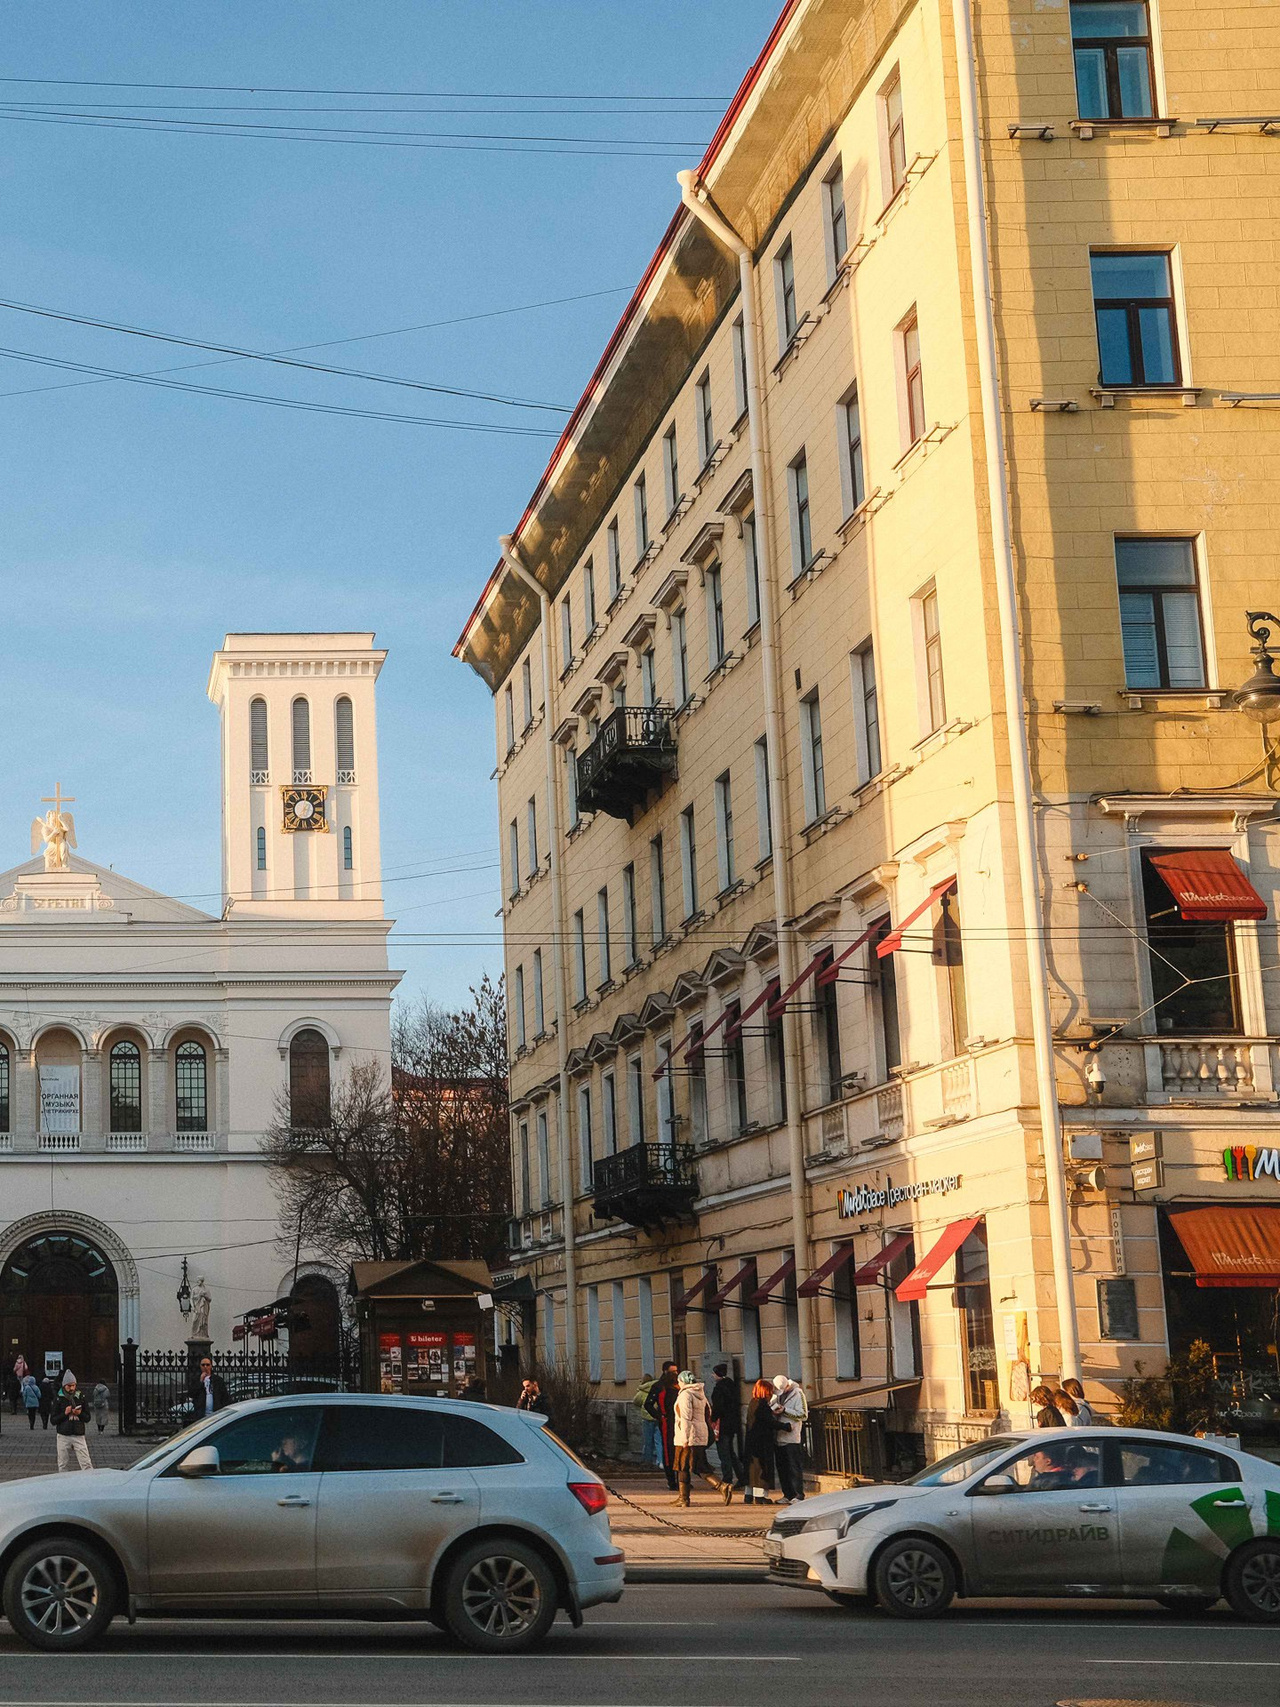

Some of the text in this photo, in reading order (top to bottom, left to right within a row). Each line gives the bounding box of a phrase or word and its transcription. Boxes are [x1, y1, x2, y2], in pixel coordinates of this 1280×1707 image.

[41, 1093, 79, 1101] ОРГАННАЯ
[1112, 1212, 1124, 1274] ПОЛИЦИЯ
[987, 1523, 1110, 1543] СИТИДРАЙВ
